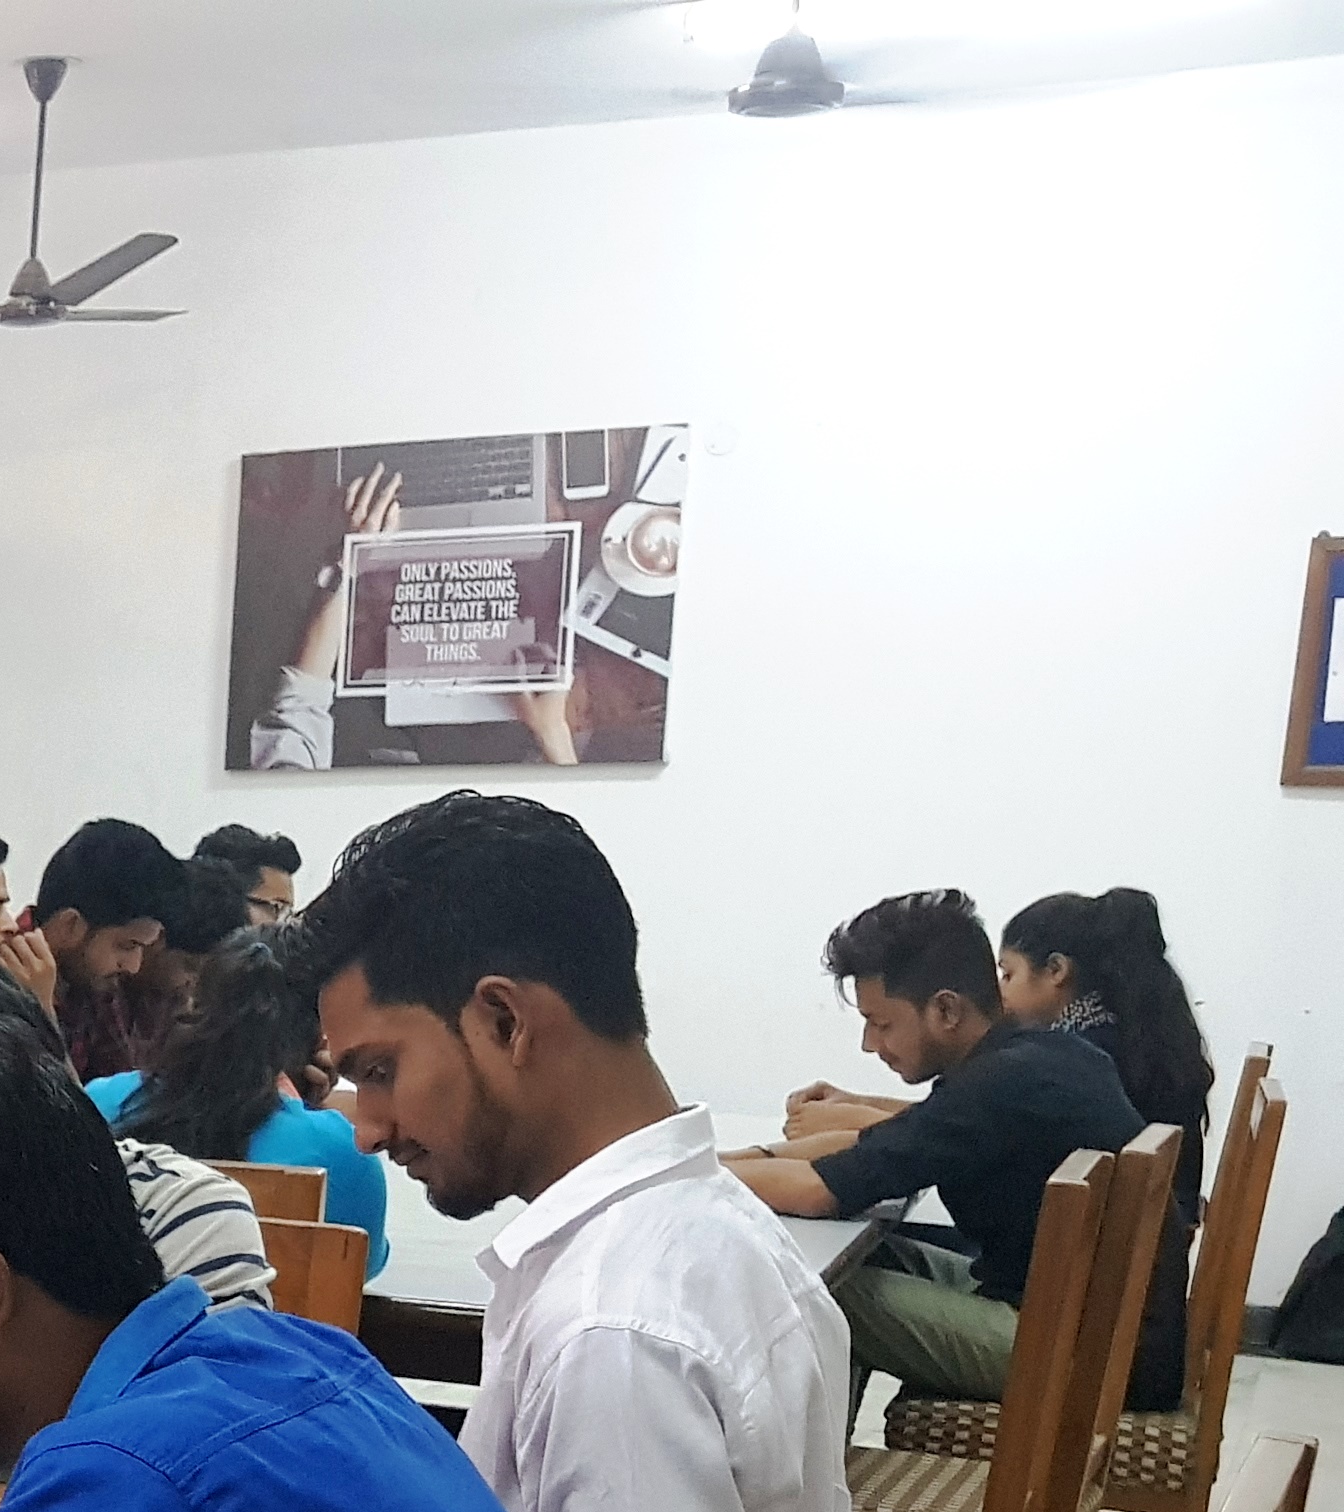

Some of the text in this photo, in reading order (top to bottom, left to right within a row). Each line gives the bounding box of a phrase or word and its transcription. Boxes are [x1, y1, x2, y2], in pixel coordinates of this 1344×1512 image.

[400, 562, 438, 582] ONLY
[394, 581, 442, 602] GREAT
[391, 599, 519, 623] CAN ELEVATE THE
[400, 620, 511, 643] SOUL TO GREAT
[425, 642, 481, 661] THINGS.
